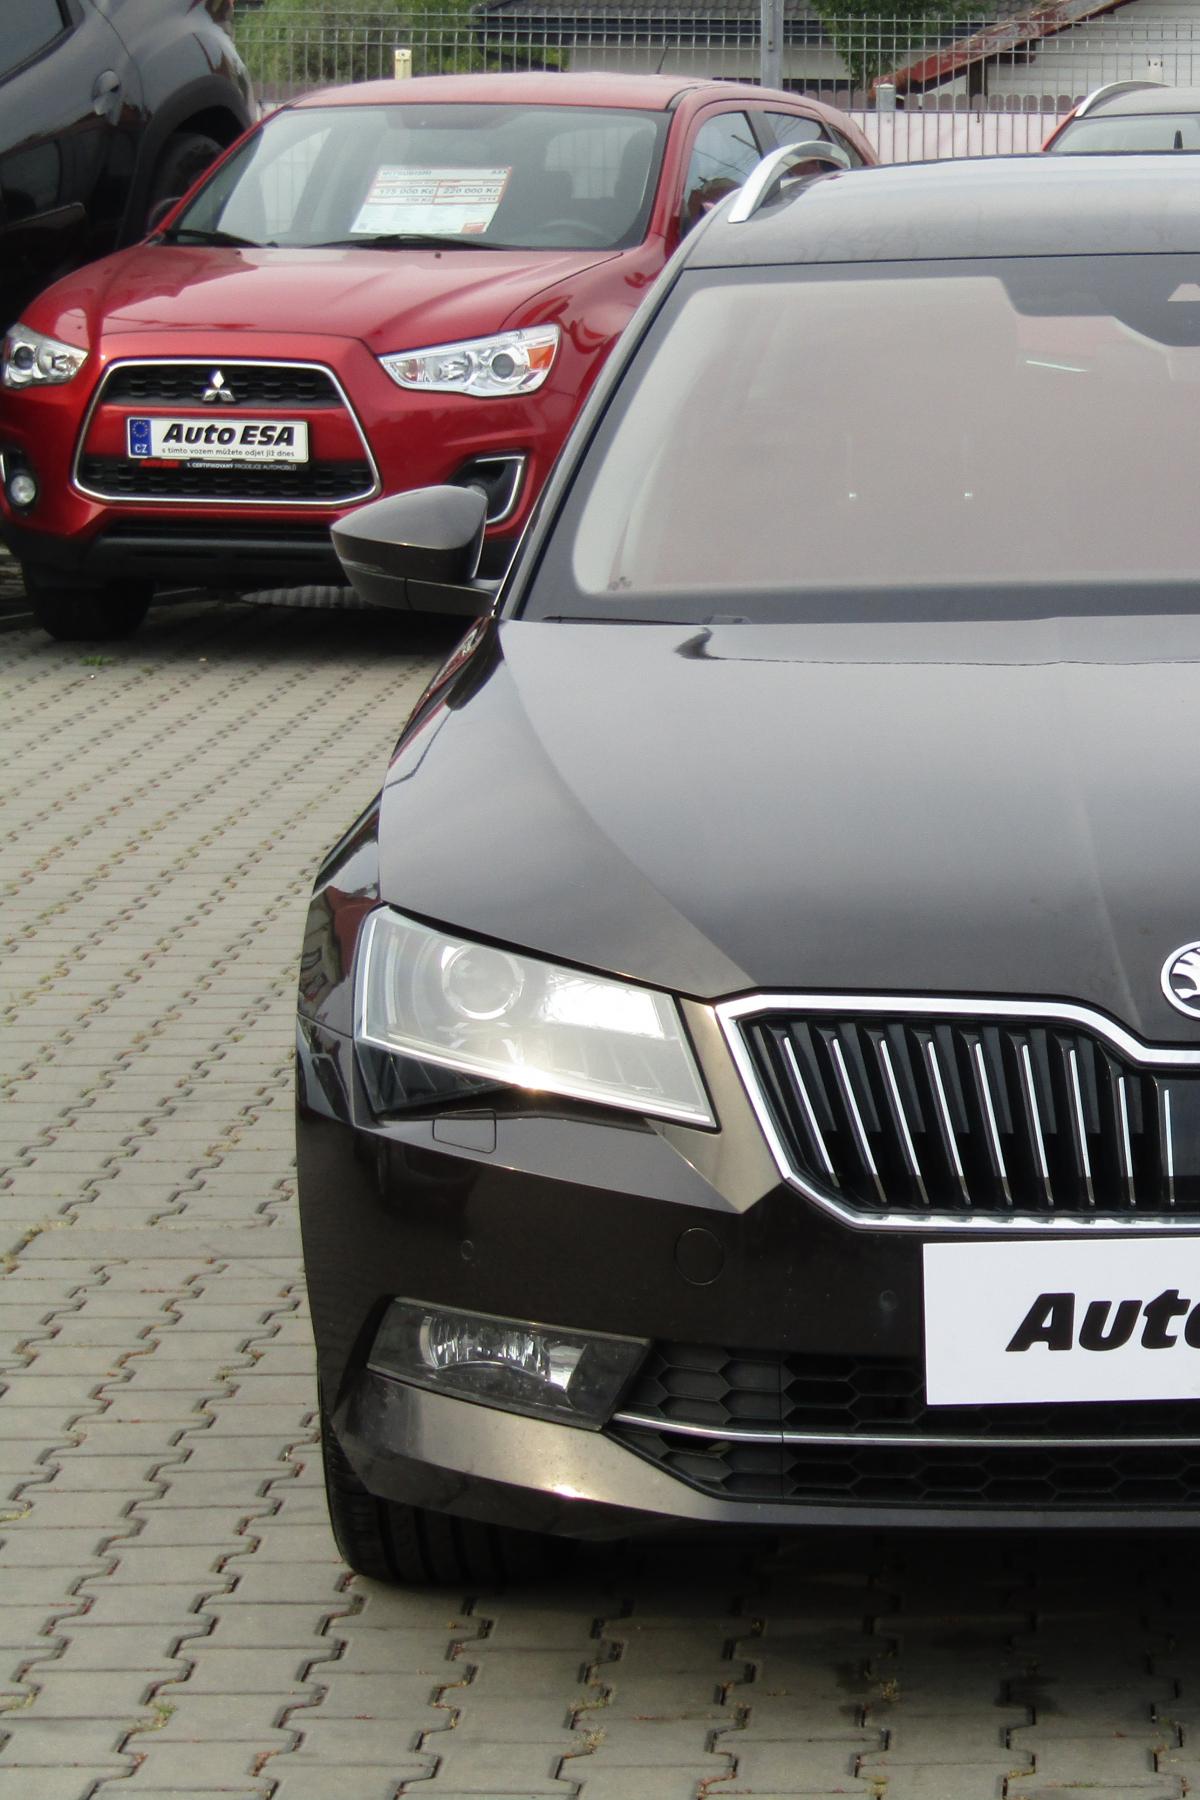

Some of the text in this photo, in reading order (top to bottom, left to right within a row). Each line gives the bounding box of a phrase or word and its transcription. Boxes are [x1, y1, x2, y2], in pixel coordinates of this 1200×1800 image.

[162, 423, 294, 446] Auto ESA
[135, 444, 148, 453] CZ
[245, 449, 264, 457] odjet
